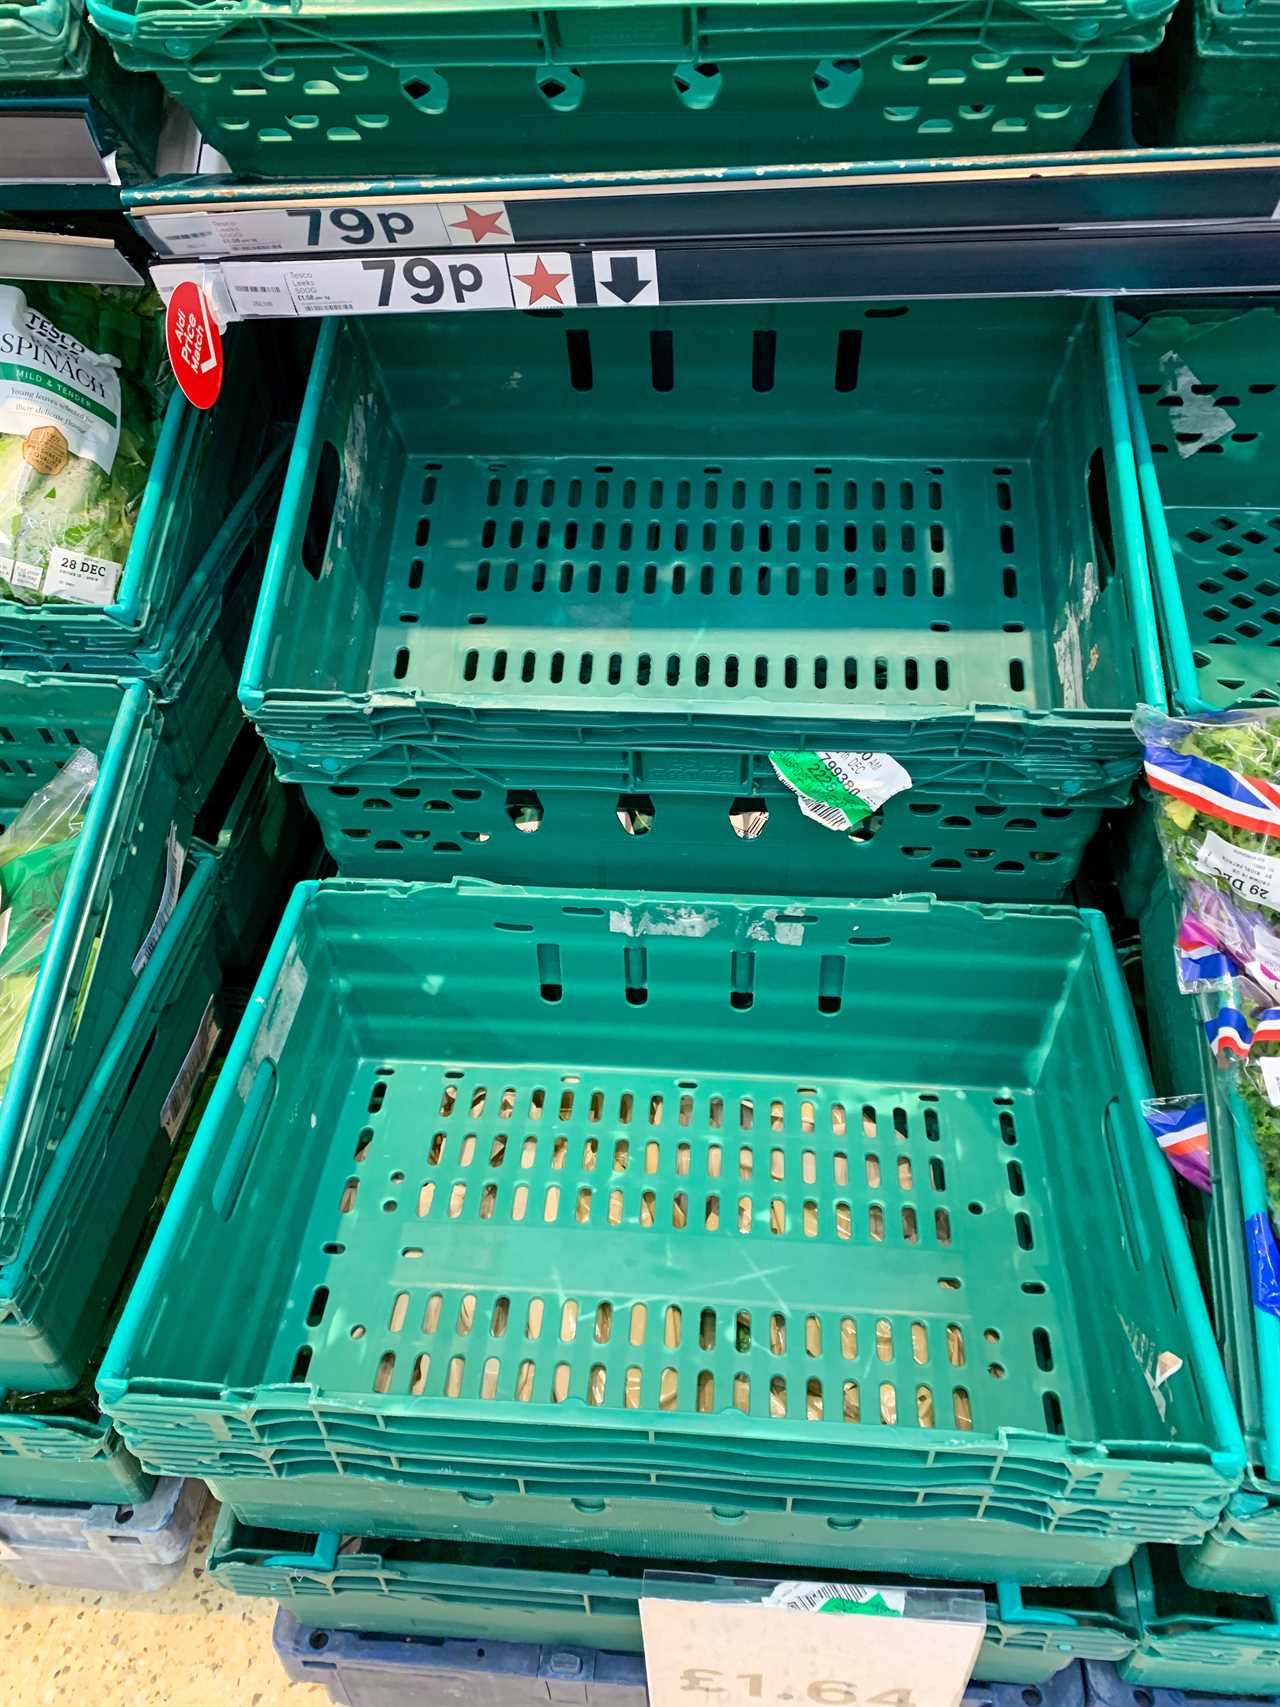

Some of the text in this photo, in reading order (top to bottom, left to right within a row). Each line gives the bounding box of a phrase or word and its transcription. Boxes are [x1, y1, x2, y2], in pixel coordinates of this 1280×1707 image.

[286, 208, 414, 246] 79p
[361, 257, 483, 307] 79p
[175, 308, 186, 344] Aldi
[181, 313, 197, 366] Price
[0, 333, 106, 399] SPINACH
[191, 325, 205, 374] Match
[15, 369, 92, 408] MILD & TENDER
[61, 558, 77, 570] 28
[80, 562, 106, 577] DEC
[1249, 884, 1270, 899] 29
[680, 1668, 916, 1707] £1.64
